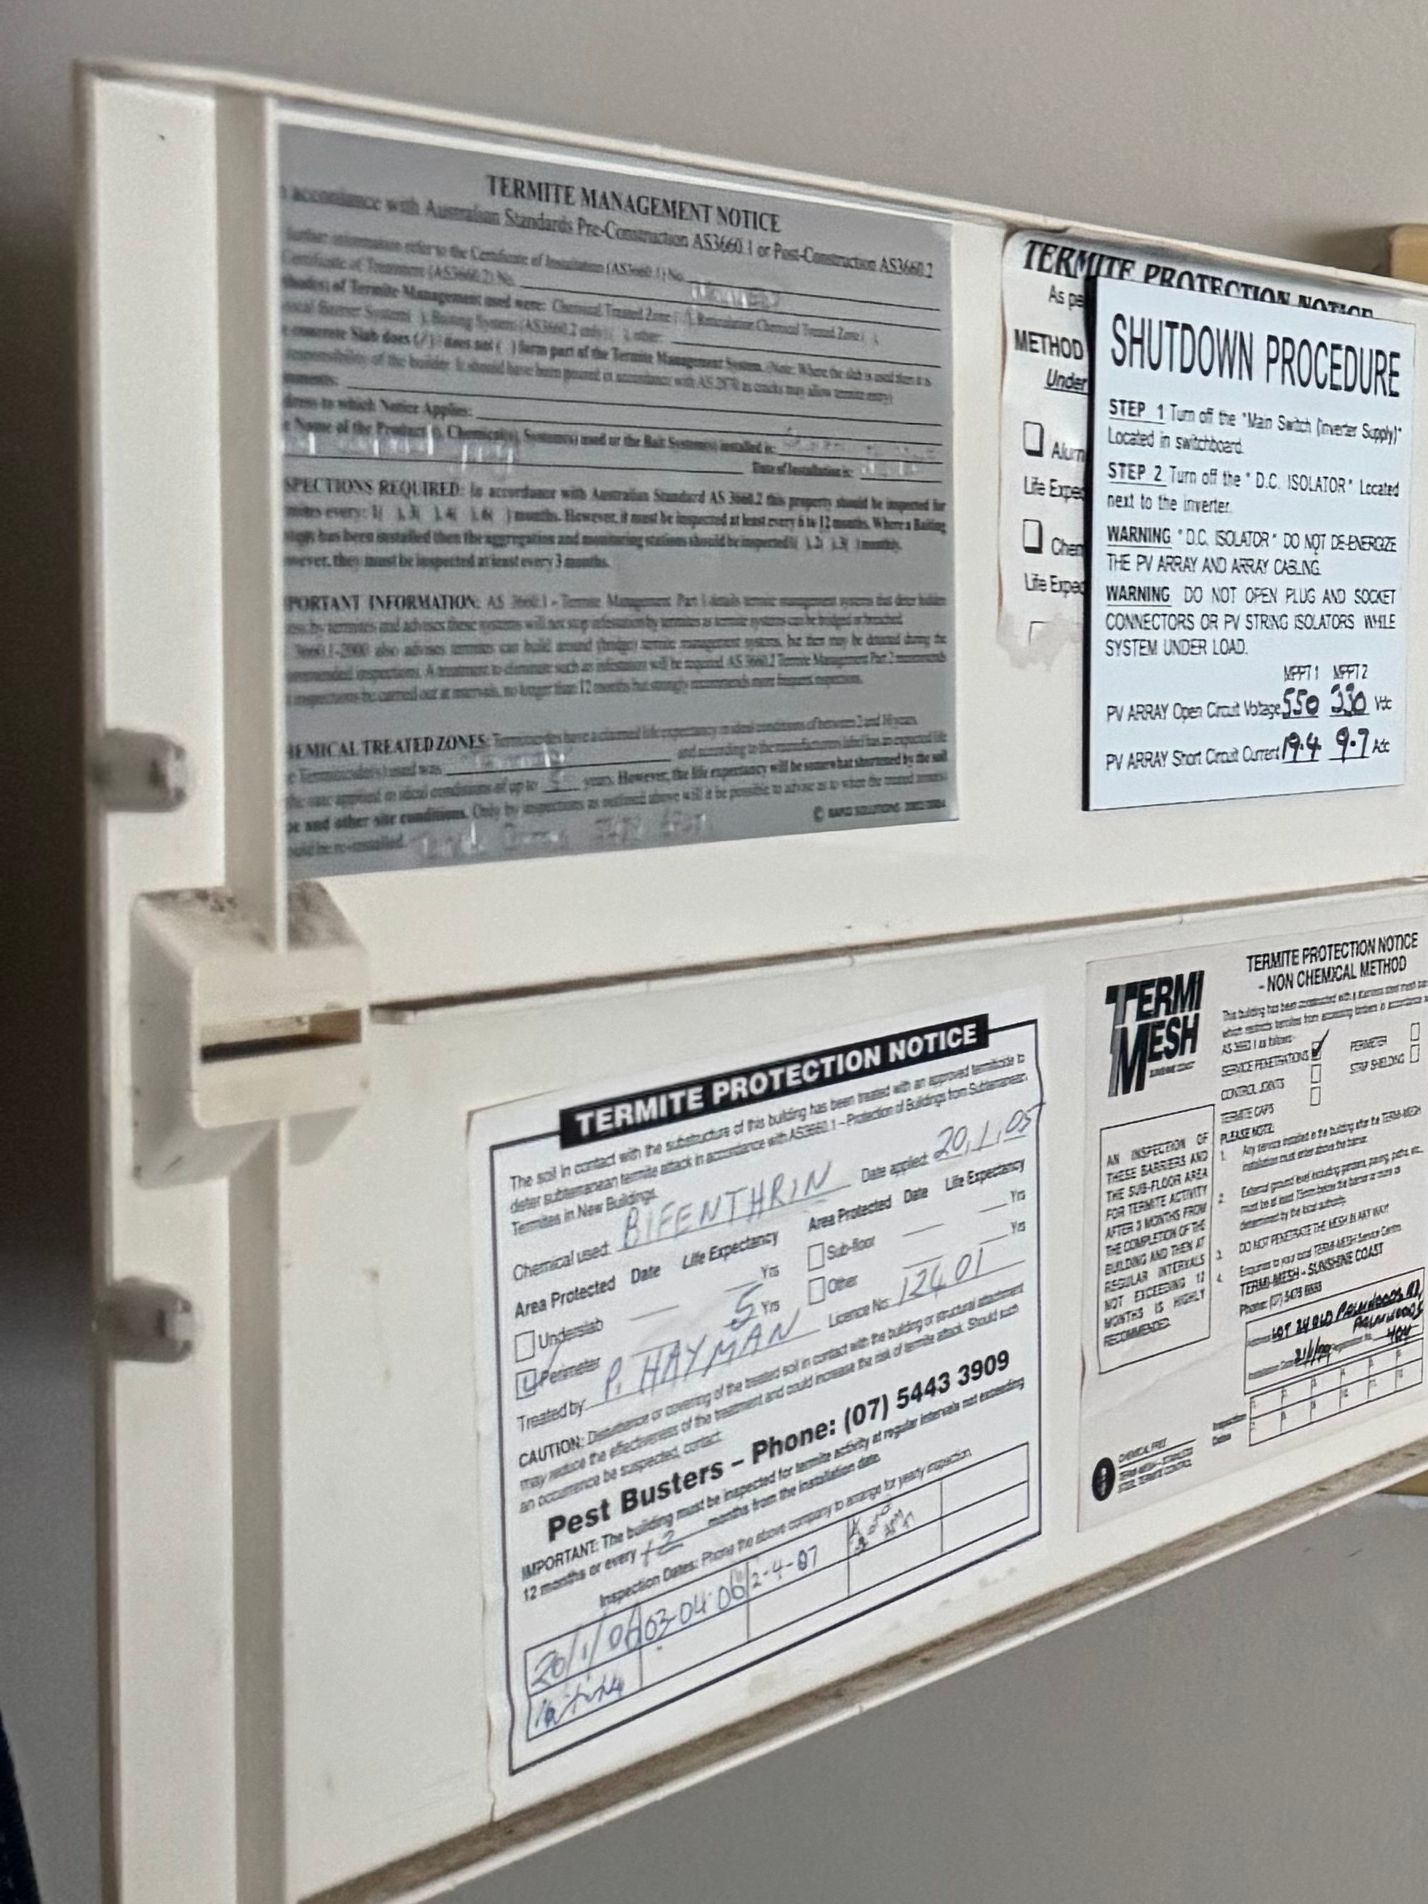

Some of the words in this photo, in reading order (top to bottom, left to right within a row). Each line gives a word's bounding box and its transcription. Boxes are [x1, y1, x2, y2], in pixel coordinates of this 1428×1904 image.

[485, 174, 576, 206] TERMITE
[580, 186, 712, 223] MANAGEMENT
[716, 204, 782, 233] NOTICE
[1111, 313, 1254, 382] SHUTDOWN
[1265, 334, 1401, 398] PROCEDURE
[1108, 398, 1146, 418] STEP
[1169, 403, 1196, 423] Turn
[1199, 407, 1214, 425] off
[1219, 409, 1237, 427] the
[1278, 415, 1312, 434] Switch
[1107, 426, 1155, 448] Located
[1159, 431, 1171, 448] in
[1108, 462, 1146, 481] STEP
[1153, 465, 1163, 482] 2
[1169, 465, 1197, 484] Turn
[1202, 467, 1218, 486] off
[1222, 470, 1241, 488] the
[1359, 478, 1400, 498] Located
[1106, 494, 1135, 509] next
[1140, 494, 1152, 511] to
[1158, 494, 1178, 512] the
[1106, 524, 1172, 545] WARNING
[1283, 532, 1300, 550] DO
[1304, 533, 1327, 552] NOT
[1106, 552, 1131, 572] THE
[1136, 553, 1153, 572] PV
[1157, 555, 1198, 574] ARRAY
[1202, 556, 1227, 574] AND
[1231, 557, 1269, 575] ARRAY
[1106, 584, 1171, 603] WARNING
[1183, 586, 1203, 604] DO
[1211, 586, 1237, 604] NOT
[1244, 587, 1278, 604] OPEN
[1285, 587, 1316, 605] PLUG
[1322, 588, 1346, 605] AND
[1354, 588, 1397, 606] SOCKET
[1105, 612, 1195, 632] CONNECTORS
[1200, 613, 1218, 631] OR
[1223, 613, 1241, 631] PV
[1244, 613, 1289, 631] STRING
[1294, 613, 1355, 631] ISOLATORS
[1363, 613, 1397, 630] WHILE
[1105, 638, 1158, 658] SYSTEM
[1163, 638, 1208, 656] UNDER
[1212, 638, 1249, 657] LOAD.
[1106, 704, 1124, 723] PV
[1127, 702, 1169, 722] ARRAY
[1172, 702, 1203, 724] Open
[1206, 700, 1241, 718] Circuit
[1243, 700, 1282, 720] Voltage
[1105, 752, 1124, 772] PV
[1126, 750, 1169, 770] ARRAY
[1171, 748, 1203, 767] Short
[1205, 745, 1241, 765] Circuit
[1242, 744, 1281, 763] Current
[1246, 949, 1300, 973] TERMITE
[1302, 936, 1377, 964] PROTECTION
[1378, 932, 1419, 953] NOTICE
[1267, 970, 1294, 992] NON
[1296, 962, 1358, 987] CHEMICAL
[1359, 955, 1407, 977] METHOD
[1105, 970, 1205, 1026] TERMI
[1109, 1013, 1200, 1097] MESH
[575, 1086, 705, 1136] TERMITE
[712, 1045, 882, 1105] PROTECTION
[888, 1023, 978, 1062] NOTICE
[861, 1167, 887, 1183] Date
[808, 1213, 836, 1232] Area
[837, 1194, 892, 1223] Protected
[903, 1187, 929, 1204] Date
[945, 1176, 965, 1192] Life
[966, 1158, 1026, 1185] Expectancy
[513, 1249, 575, 1281] Chemical
[1355, 1242, 1385, 1262] COAST
[514, 1295, 547, 1318] Area
[550, 1275, 617, 1309] Protected
[631, 1264, 662, 1285] Date
[682, 1251, 706, 1270] Life
[708, 1230, 779, 1261] Expectancy
[828, 1302, 871, 1328] Licence
[548, 1498, 612, 1543] Pest
[620, 1460, 724, 1516] Busters
[751, 1418, 837, 1466] Phone:
[844, 1392, 889, 1438] (07)
[896, 1371, 951, 1411] 5443
[957, 1349, 1010, 1387] 3909
